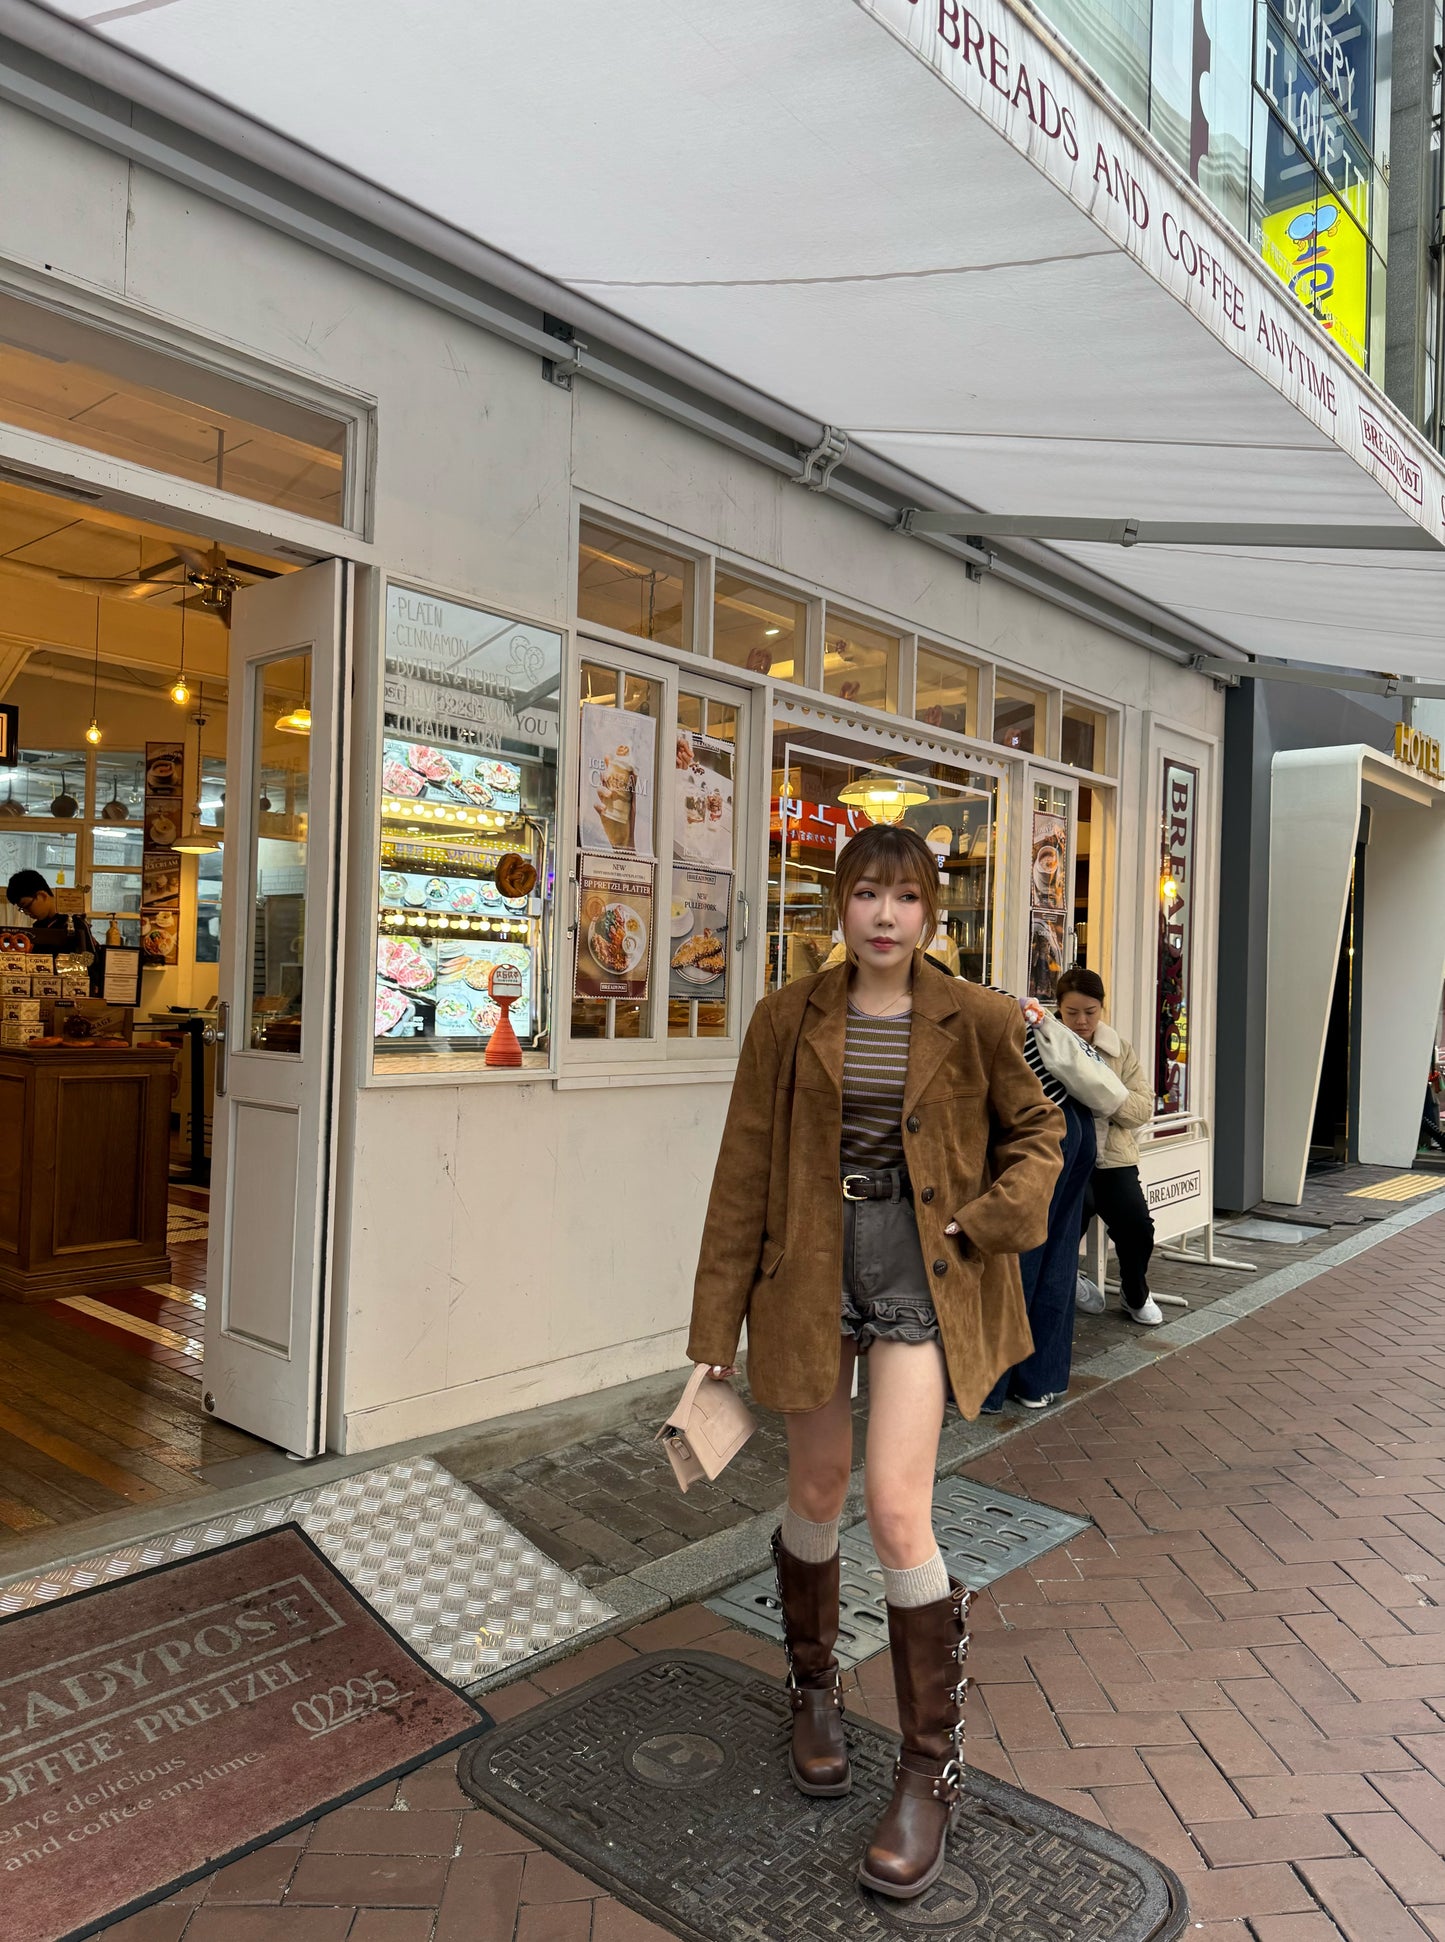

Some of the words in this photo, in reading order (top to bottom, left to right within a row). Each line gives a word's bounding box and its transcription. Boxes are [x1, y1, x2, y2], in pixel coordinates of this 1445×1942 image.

[1288, 71, 1335, 185] LOVE
[938, 0, 1079, 161] BREADS
[1093, 142, 1149, 230] AND
[1162, 212, 1246, 332] COFFEE
[1257, 309, 1337, 416] ANYTIME
[1363, 418, 1420, 493] BREADYPOST
[397, 597, 442, 628] PLAIN
[395, 624, 470, 658] CINNAMON
[395, 655, 449, 684] BUTTER
[465, 666, 514, 697] PEPPER
[397, 714, 450, 743] TOMATO
[515, 713, 548, 736] YOU
[589, 757, 606, 771] ICE
[1394, 722, 1445, 780] HOTEL
[584, 880, 593, 888] BP
[593, 881, 622, 891] PRETZEL
[622, 884, 651, 895] PLATTER
[613, 863, 626, 871] NEW
[1163, 779, 1188, 1113] BREADYPOST
[1149, 1177, 1199, 1204] BREADYPOST
[133, 1660, 312, 1743] PRETZEL
[292, 1669, 397, 1732] 02295
[66, 1755, 186, 1814] delicious
[5, 1835, 62, 1871] and
[67, 1798, 154, 1842] coffee
